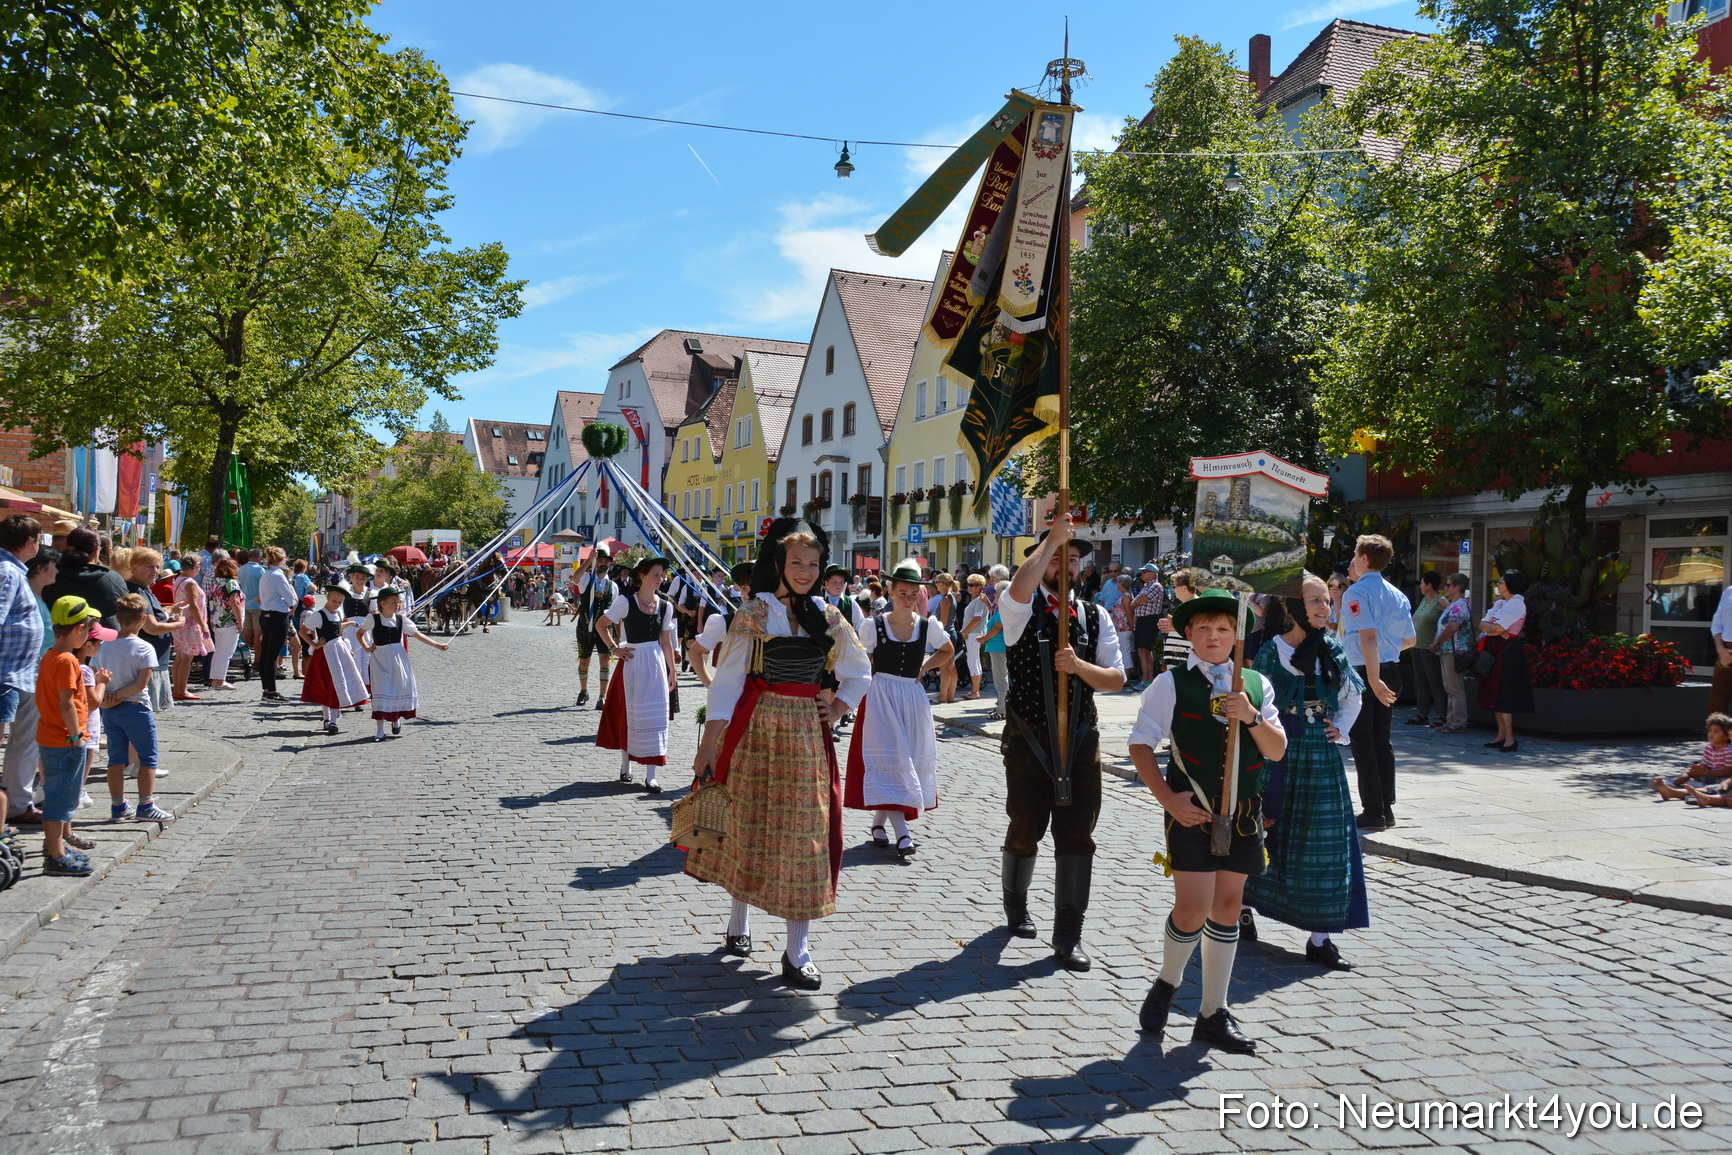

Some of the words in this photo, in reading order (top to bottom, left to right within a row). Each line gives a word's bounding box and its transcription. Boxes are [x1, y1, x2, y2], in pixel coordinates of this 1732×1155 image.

[686, 474, 701, 487] HOTEL
[1202, 458, 1252, 472] Almenrausch
[1271, 463, 1307, 484] Neumarkt
